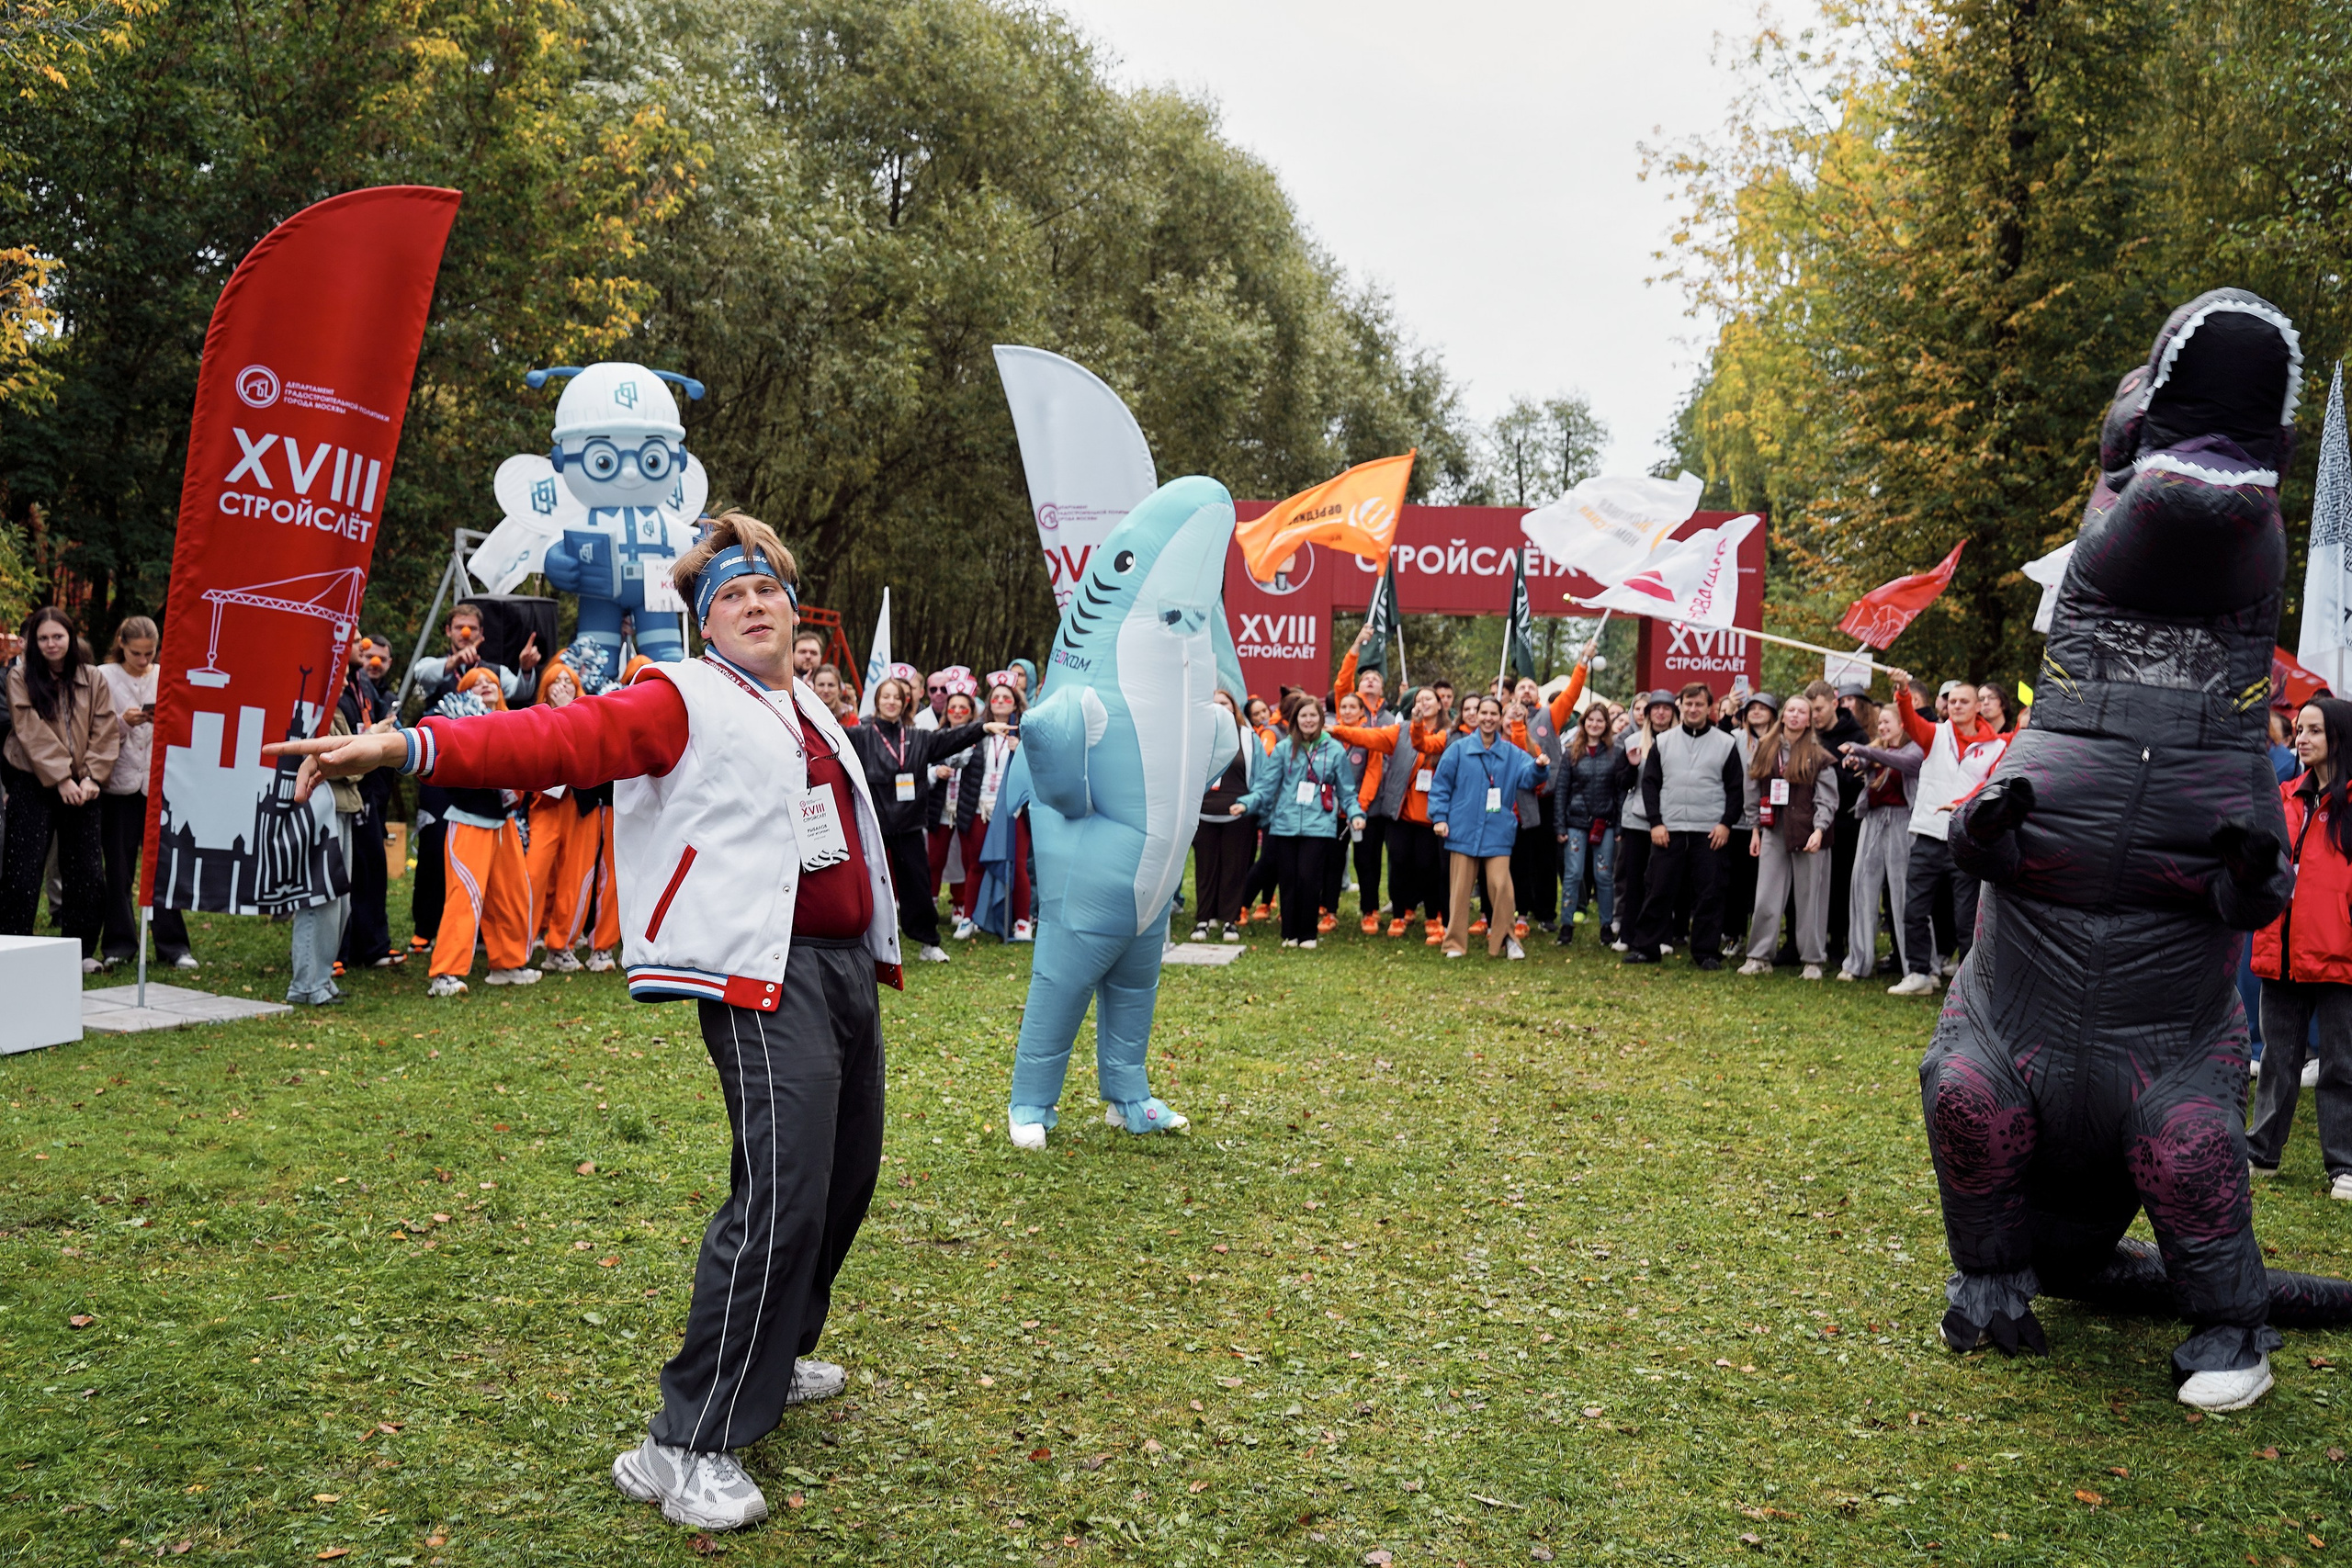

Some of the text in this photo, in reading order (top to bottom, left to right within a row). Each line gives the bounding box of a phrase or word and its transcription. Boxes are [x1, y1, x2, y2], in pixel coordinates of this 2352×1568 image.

[286, 381, 334, 395] ДЕПАРТАМЕНТ
[283, 396, 346, 414] ГОРОДА МОСКВЫ
[223, 426, 381, 513] XVIII
[218, 491, 372, 544] СТРОЙСЛЁТ
[1238, 614, 1316, 644] XVIII
[1667, 626, 1746, 657] XVIII
[1237, 642, 1316, 660] СТРОЙСЛЁТ
[1665, 655, 1747, 672] СТРОЙСЛЁТ
[801, 803, 825, 818] XVIII
